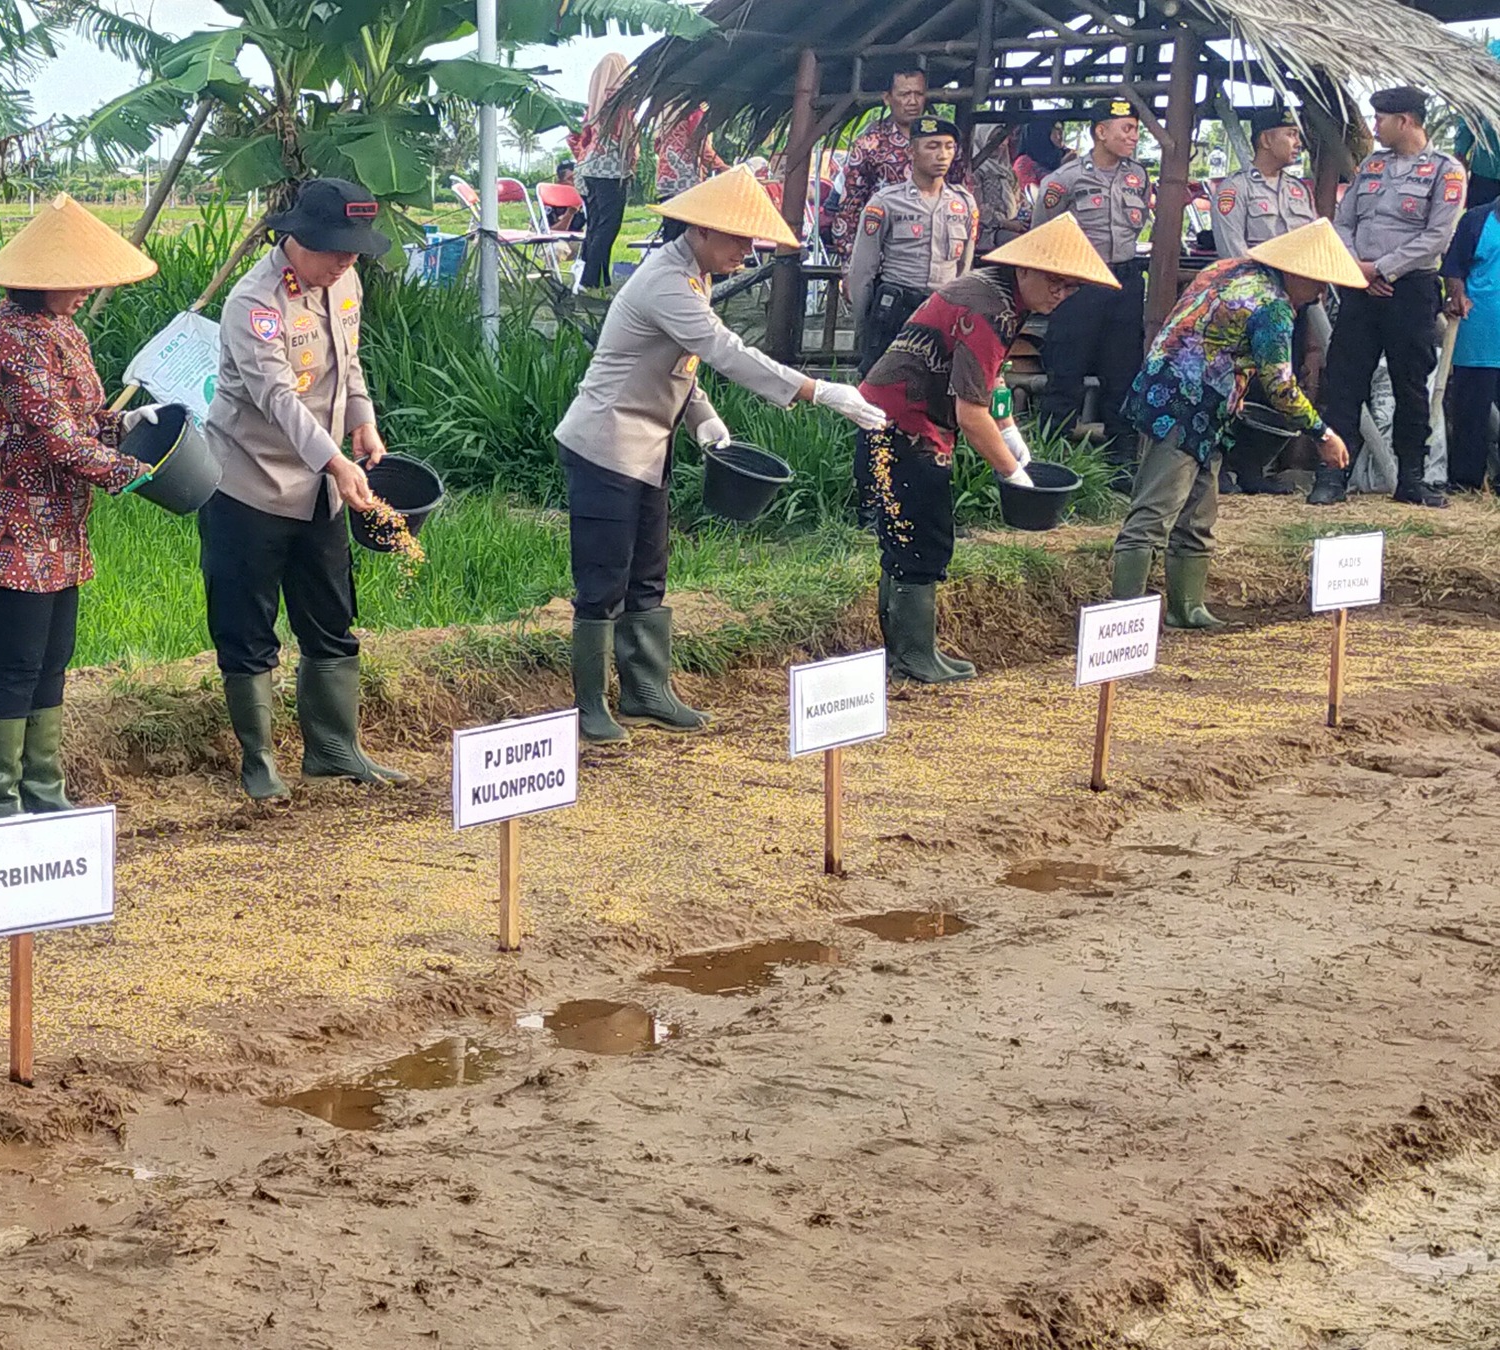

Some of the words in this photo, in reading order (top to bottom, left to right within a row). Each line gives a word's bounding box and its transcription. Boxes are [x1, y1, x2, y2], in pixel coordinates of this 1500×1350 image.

[342, 312, 359, 329] POLR
[291, 334, 310, 348] EDY
[310, 329, 320, 341] M
[1338, 557, 1362, 569] KADIS
[1098, 617, 1145, 641] KAPOLRES
[1088, 642, 1149, 669] KULONPROGO
[805, 692, 876, 720] KAKORBINMAS
[484, 748, 502, 770] PJ
[505, 737, 552, 766] BUPATI
[471, 768, 566, 806] KULONPROGO
